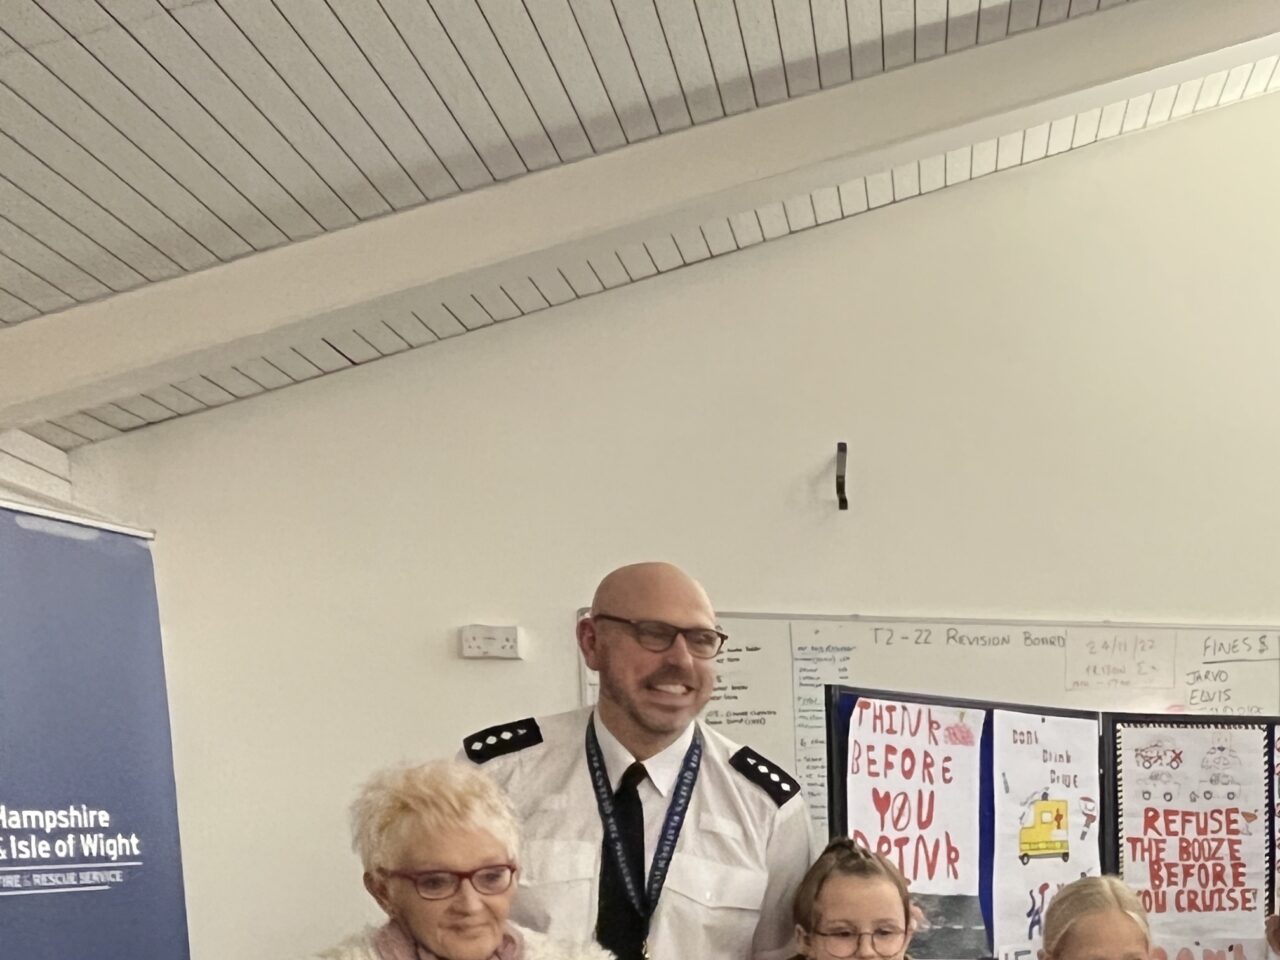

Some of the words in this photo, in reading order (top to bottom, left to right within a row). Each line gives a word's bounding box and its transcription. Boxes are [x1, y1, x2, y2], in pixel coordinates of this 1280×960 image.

[946, 627, 1011, 646] REVISION
[1023, 630, 1065, 648] BOARD
[1203, 635, 1252, 656] FINES
[1186, 669, 1229, 685] JARVO
[1189, 688, 1232, 705] ELVIS
[857, 700, 942, 746] THINK
[850, 739, 954, 786] BEFORE
[871, 786, 936, 832] YOU
[1142, 806, 1241, 837] REFUSE
[9, 834, 51, 859] Isle
[54, 833, 75, 858] of
[80, 832, 141, 861] Wight
[1126, 837, 1167, 863] THE
[1178, 837, 1242, 863] BOOZE
[32, 872, 78, 886] RESCUE
[79, 870, 123, 884] SERVICE
[1148, 860, 1247, 890] BEFORE
[1136, 889, 1167, 914] OU
